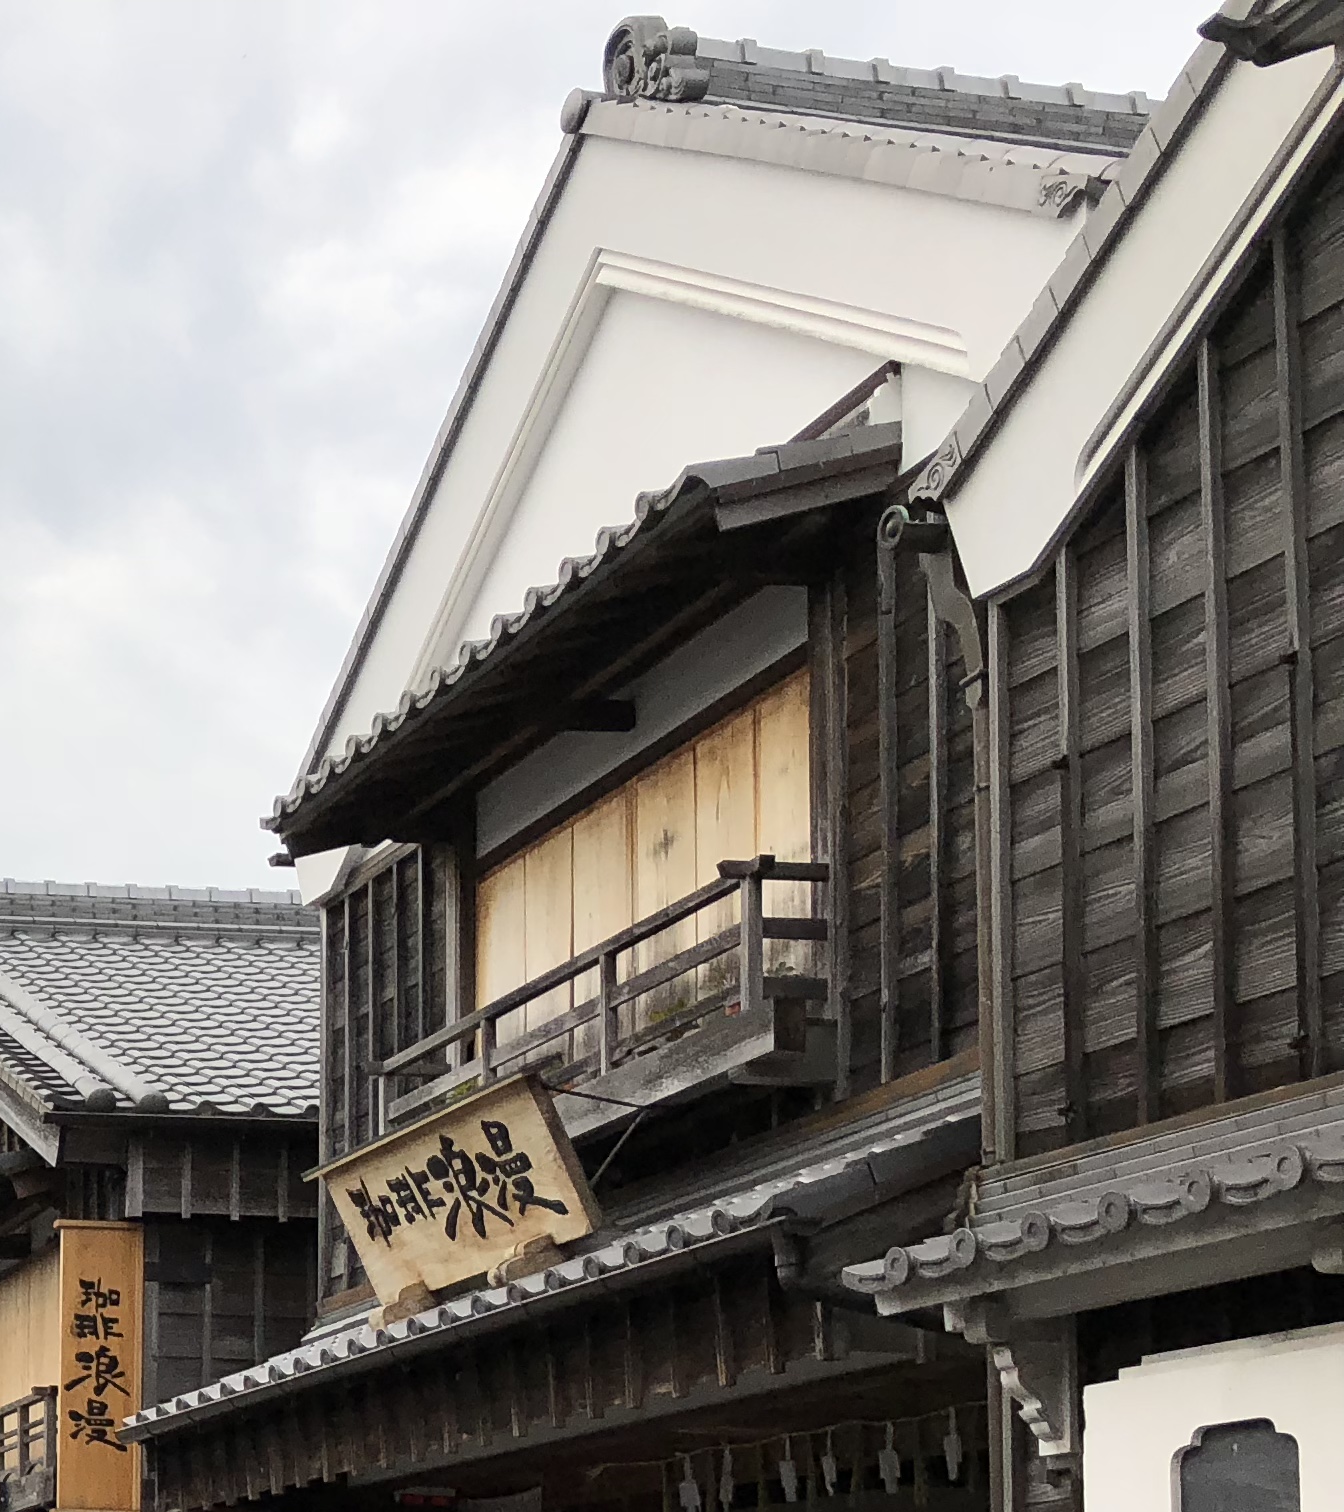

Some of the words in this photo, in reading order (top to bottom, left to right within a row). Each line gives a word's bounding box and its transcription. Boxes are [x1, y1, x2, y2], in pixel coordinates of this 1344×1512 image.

[348, 1120, 568, 1244] 珈琲浪漫
[64, 1279, 132, 1452] 珈琲浪漫
